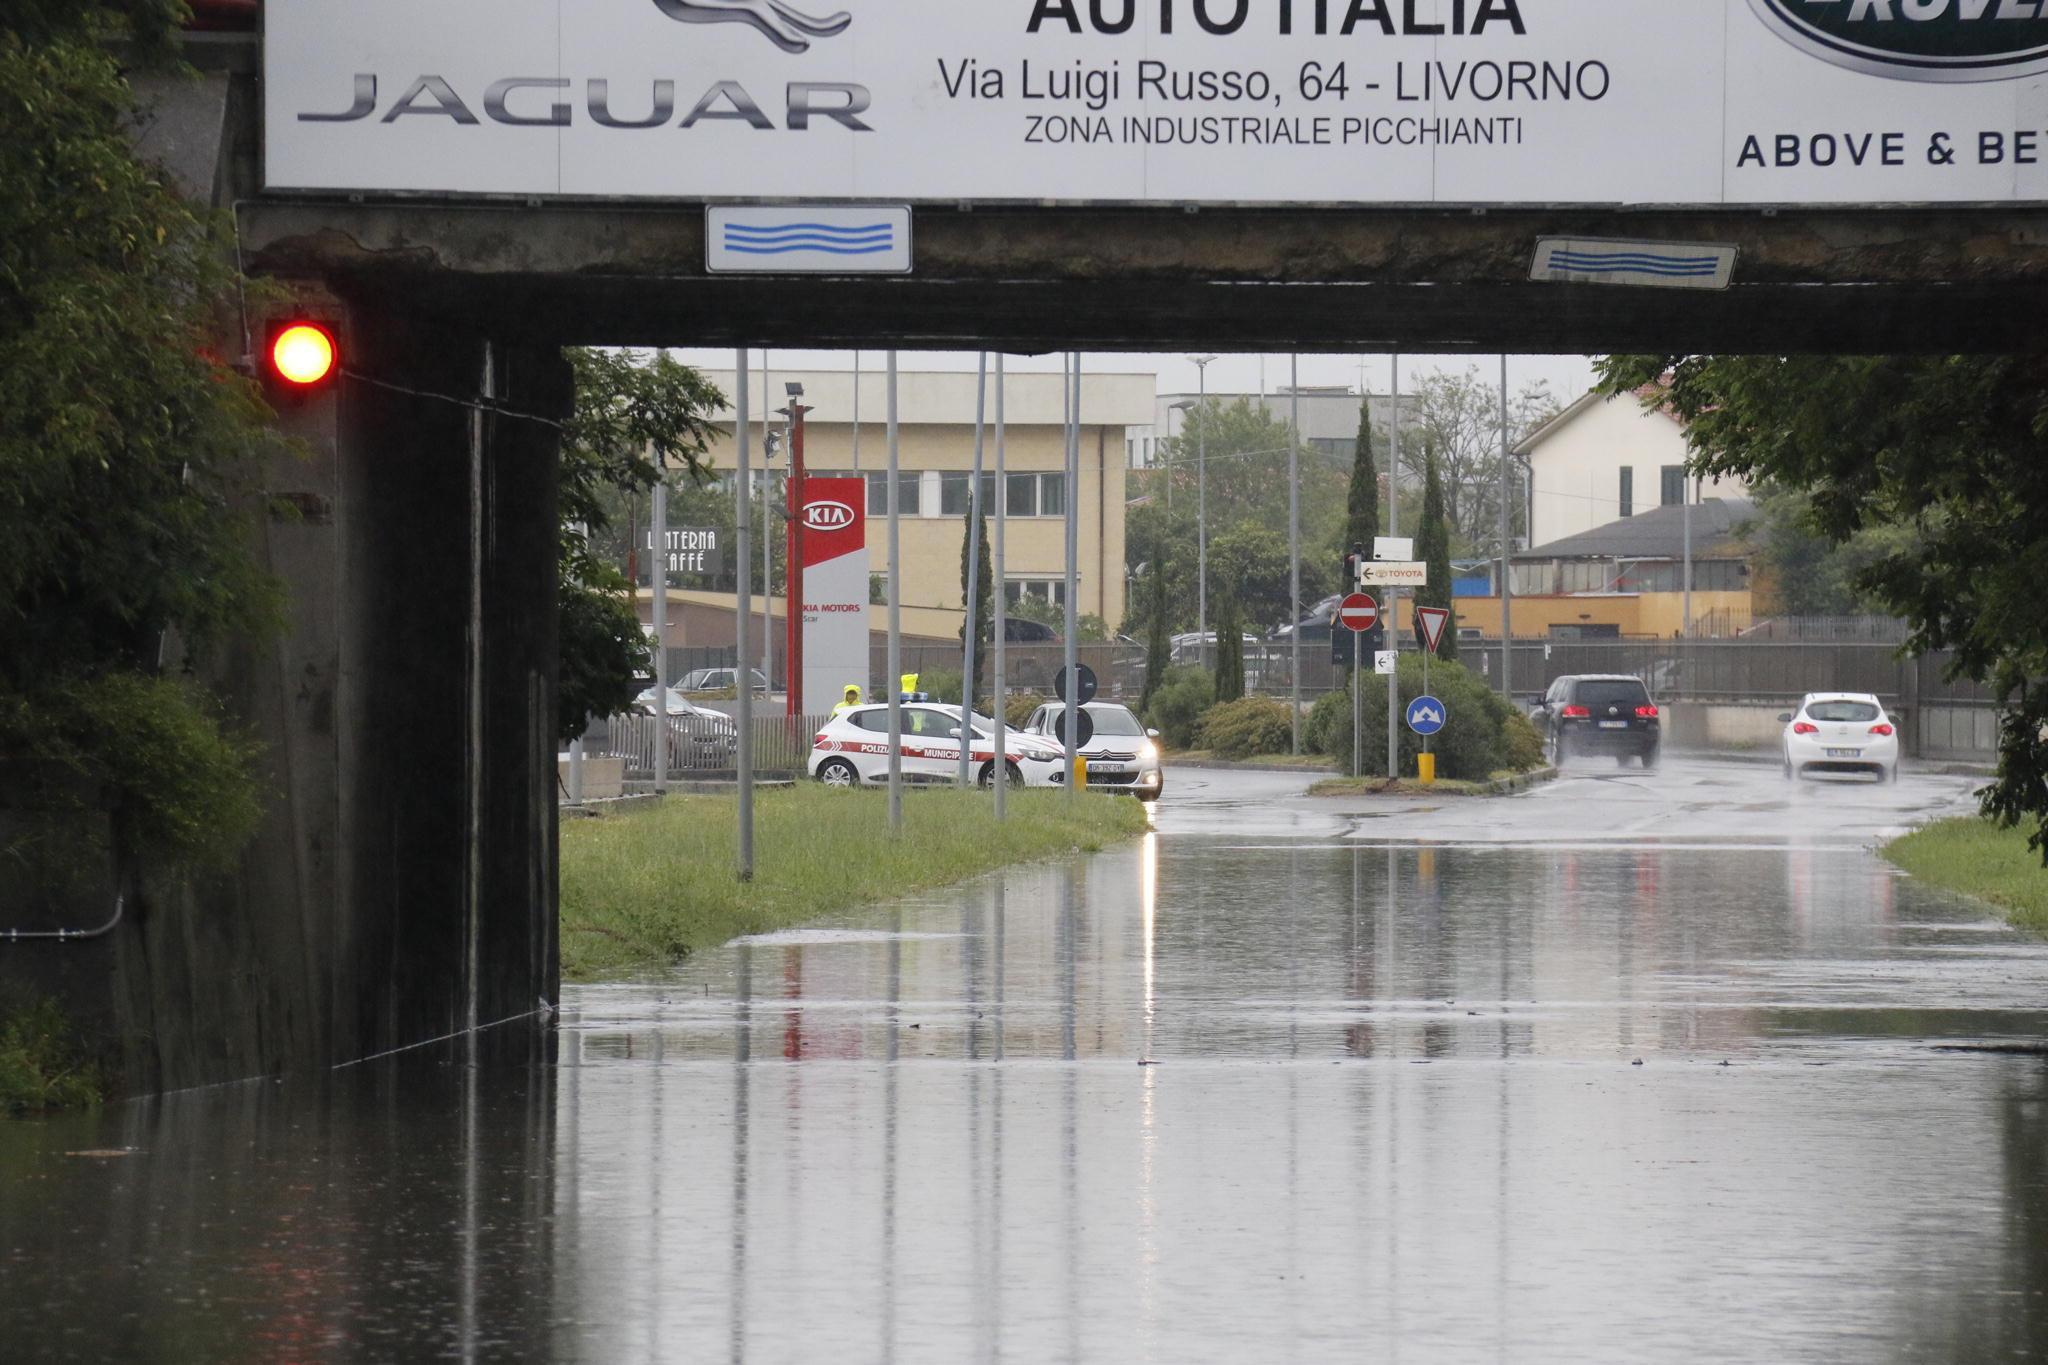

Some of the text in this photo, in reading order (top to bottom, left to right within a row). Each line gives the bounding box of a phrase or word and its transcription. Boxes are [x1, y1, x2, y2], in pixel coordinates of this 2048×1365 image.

[937, 58, 1004, 99] Via
[1022, 59, 1120, 110] Luigi
[1138, 60, 1281, 107] Russo,
[1299, 61, 1349, 101] 64
[1397, 60, 1610, 102] LIVORNO
[297, 72, 875, 132] JAGUAR
[1024, 115, 1522, 145] ZONA INDUSTRIALE PICCHIANTI
[1736, 130, 2048, 168] ABOVE & BE
[808, 507, 846, 523] KIA
[647, 531, 716, 550] LNTERNA
[665, 550, 705, 572] AFFÉ
[802, 604, 860, 612] KIA MOTORS
[861, 743, 974, 760] POLIZI MUNICIPE
